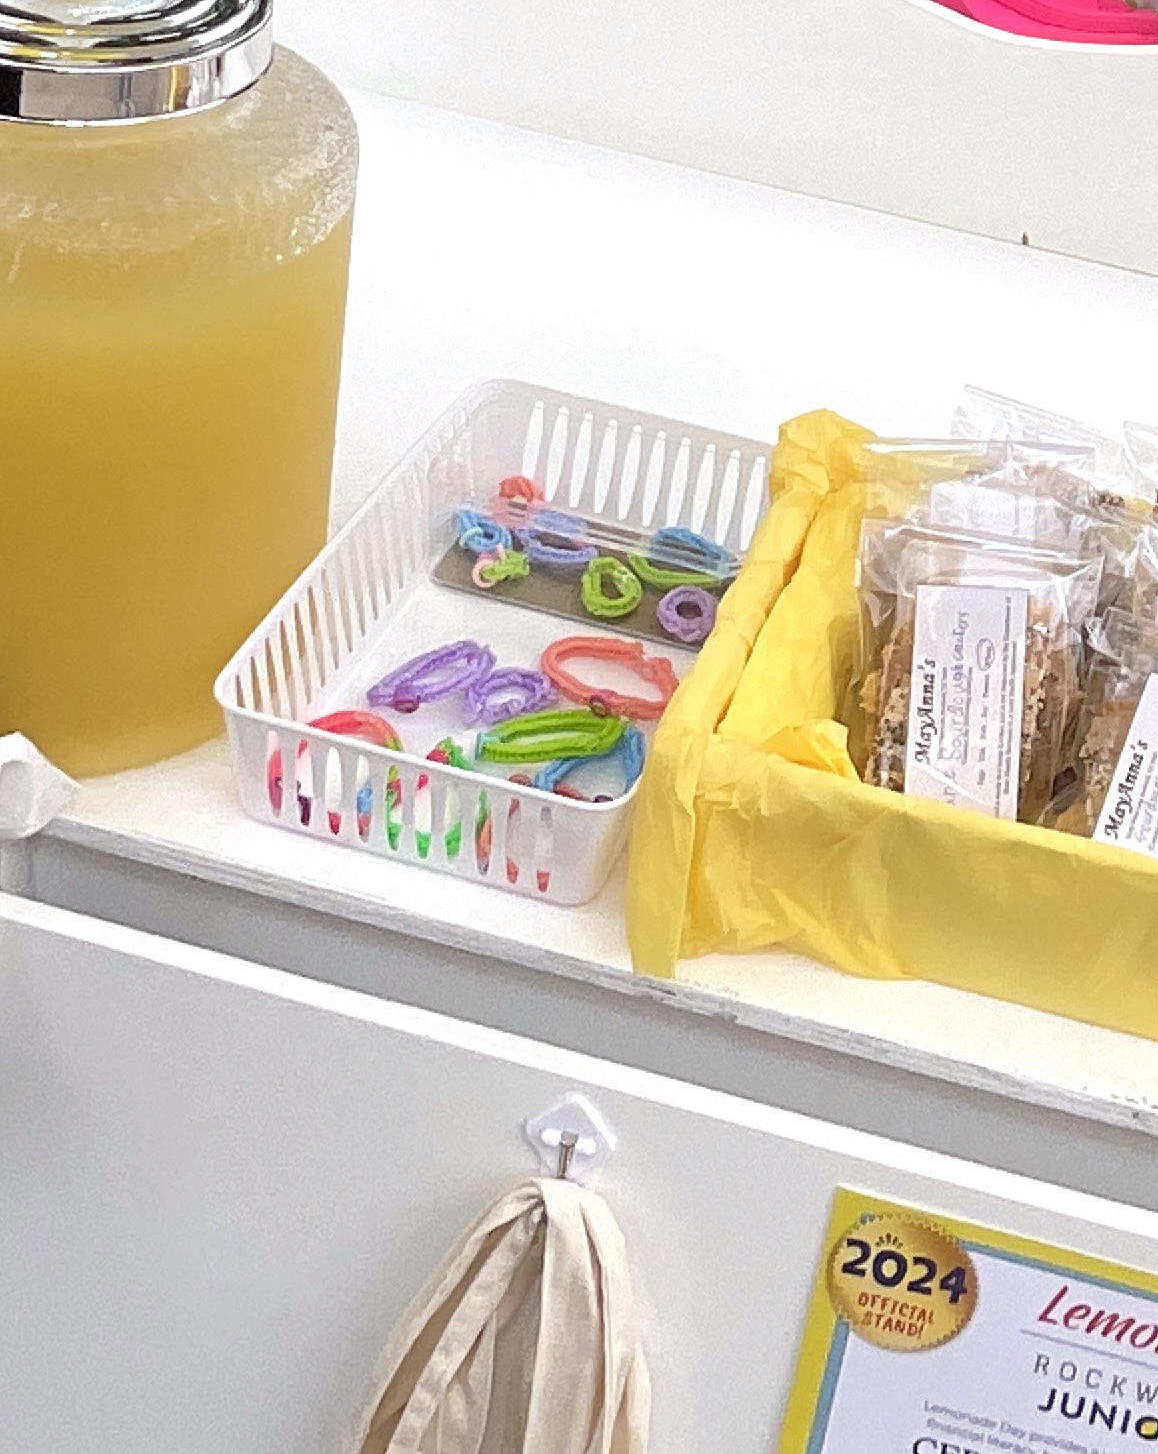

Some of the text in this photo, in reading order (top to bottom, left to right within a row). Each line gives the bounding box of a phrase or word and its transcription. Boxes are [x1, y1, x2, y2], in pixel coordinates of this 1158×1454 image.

[915, 659, 935, 763] MayAnna's
[1105, 740, 1147, 839] MayAnna's
[840, 1239, 969, 1305] 2024
[858, 1292, 933, 1327] OFFICIAL
[861, 1312, 924, 1338] STAND!
